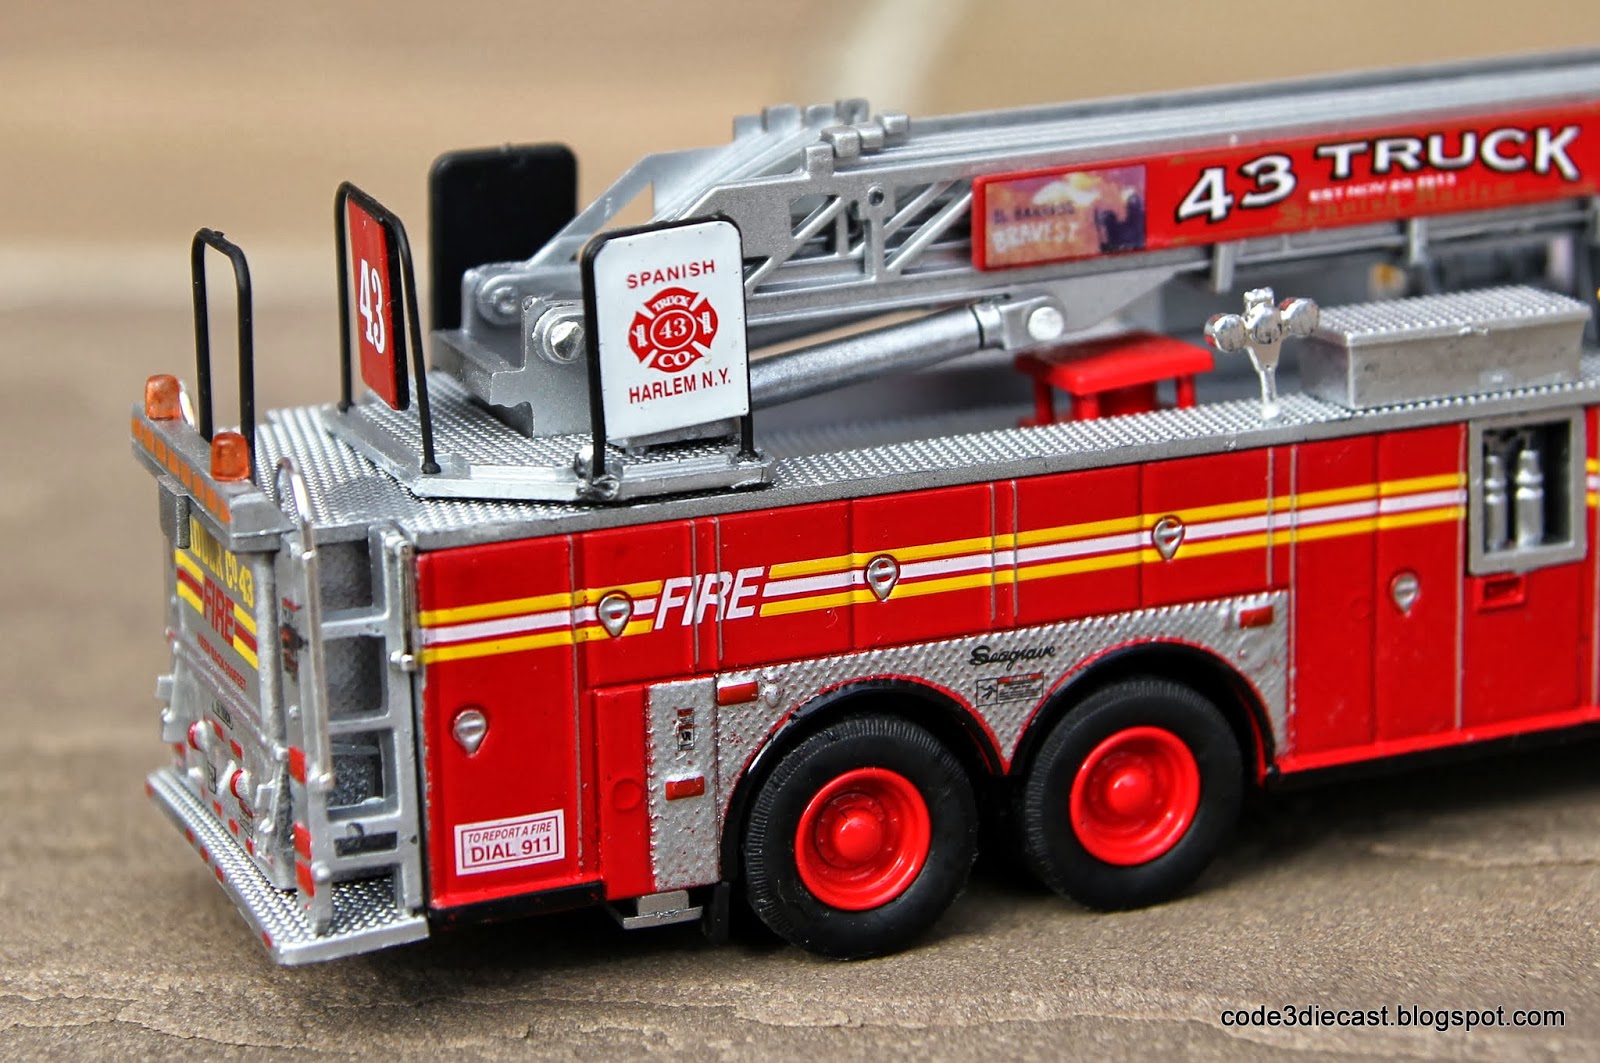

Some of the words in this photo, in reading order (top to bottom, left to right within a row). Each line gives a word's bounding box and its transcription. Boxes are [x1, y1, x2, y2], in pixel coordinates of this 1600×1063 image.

[1174, 151, 1299, 224] 43
[1313, 124, 1582, 181] TRUCK
[626, 259, 715, 289] SPANISH
[360, 258, 385, 354] 43
[651, 294, 690, 312] TRUCK
[658, 316, 688, 340] 43
[657, 350, 696, 368] CO.
[628, 374, 697, 404] HARLEM
[701, 367, 732, 390] N.Y.
[203, 574, 235, 648] FIRE
[654, 565, 766, 630] FIRE
[969, 644, 1056, 672] Seagrave
[468, 832, 481, 844] TO
[482, 826, 521, 842] REPORT
[521, 826, 529, 837] A
[530, 821, 552, 836] FIRE
[471, 842, 516, 863] DIAL
[521, 836, 551, 855] 911
